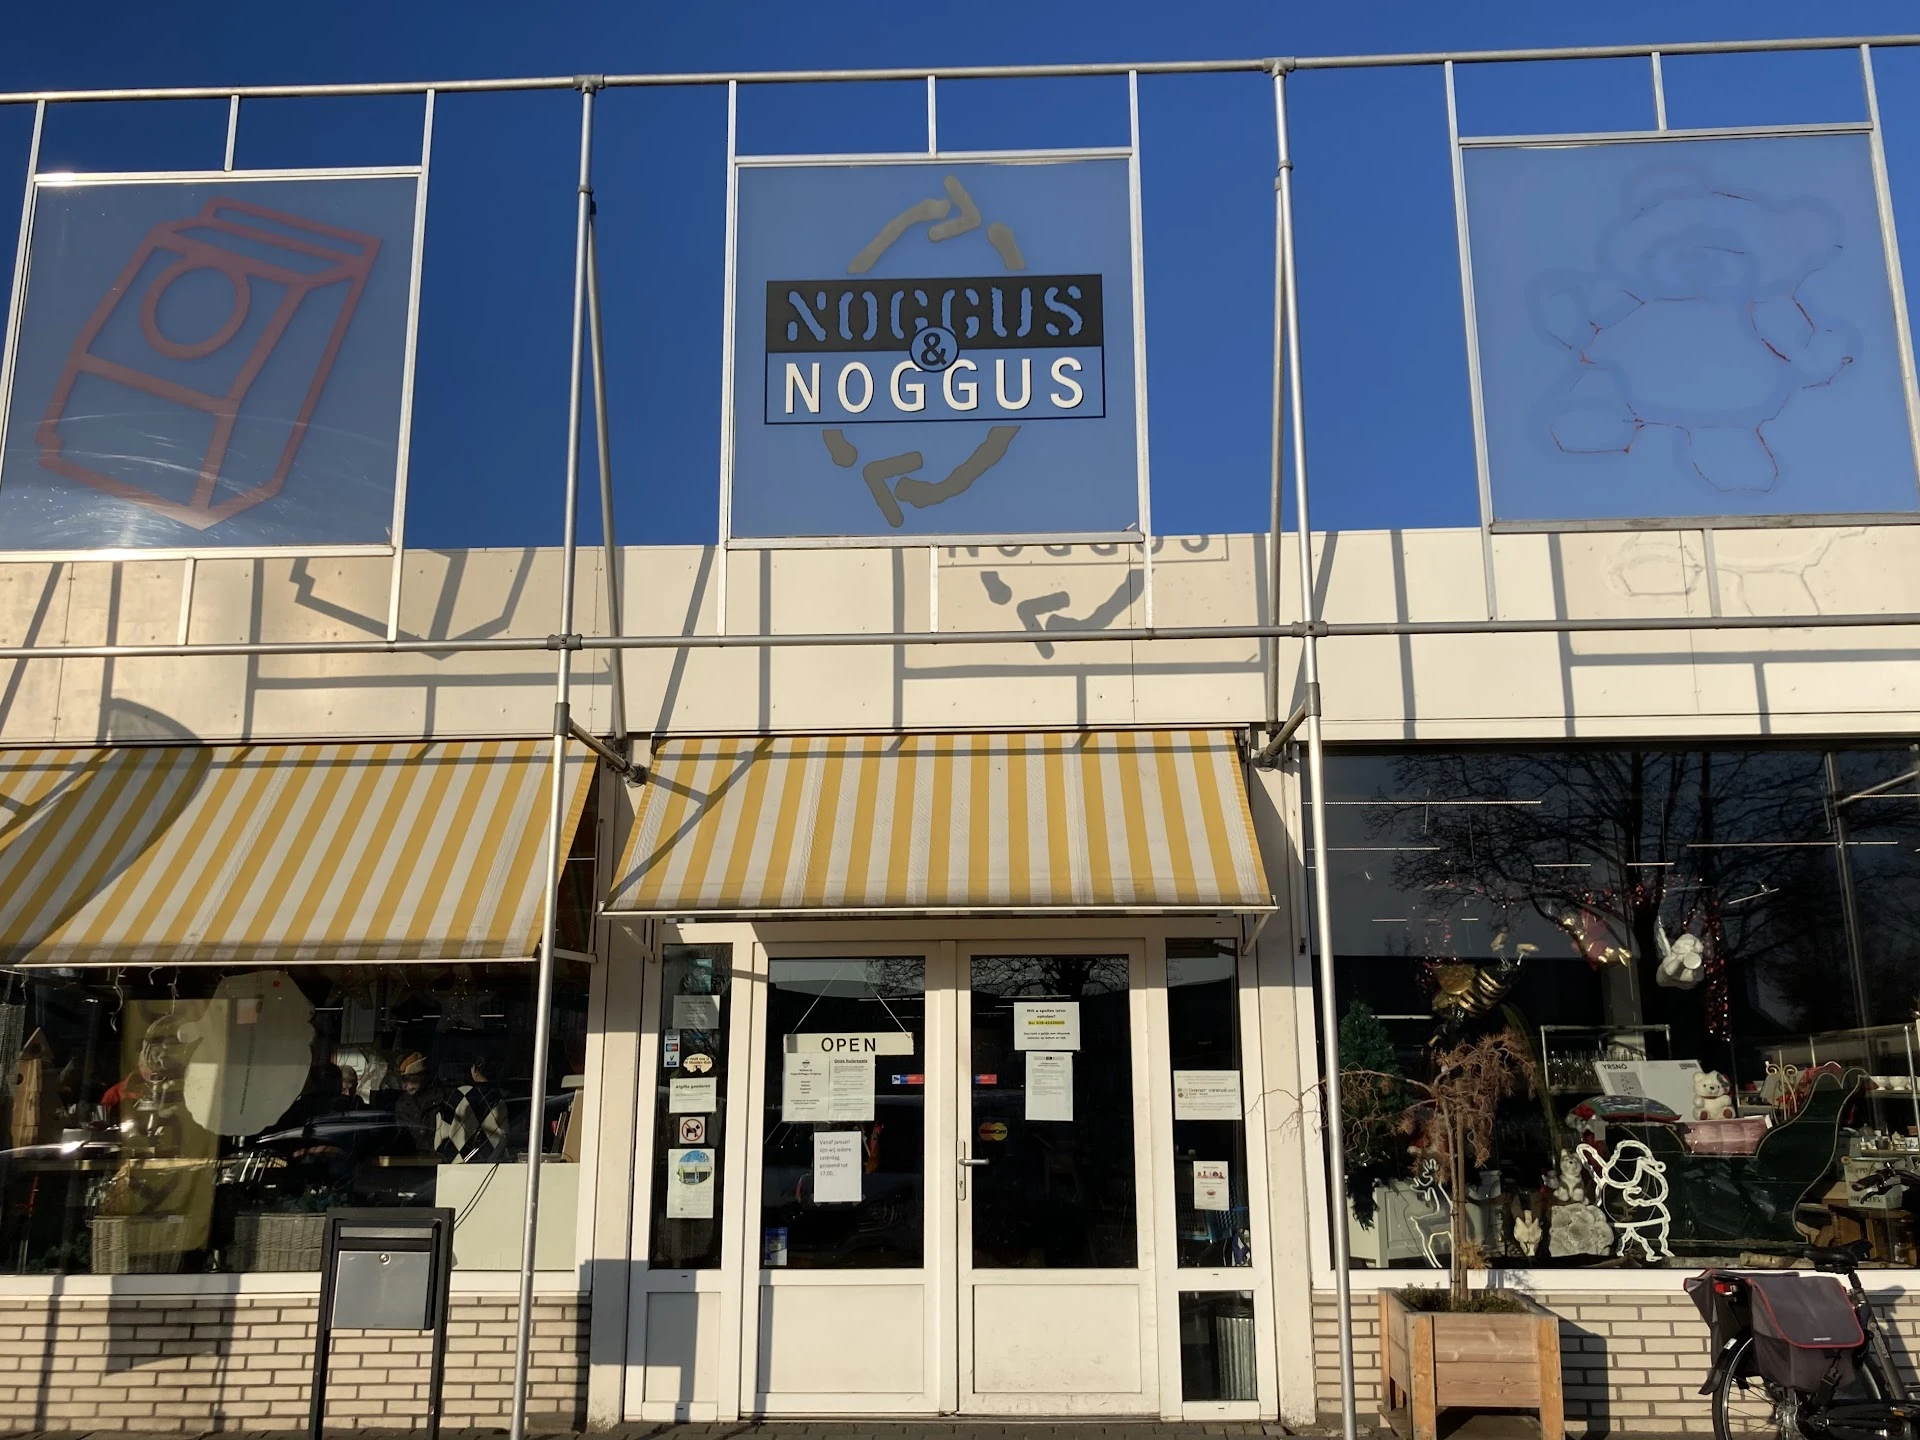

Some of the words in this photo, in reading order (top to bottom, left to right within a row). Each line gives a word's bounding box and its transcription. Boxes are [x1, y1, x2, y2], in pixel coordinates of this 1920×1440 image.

[786, 285, 1085, 343] NOGGUS
[920, 332, 947, 367] &
[784, 356, 1086, 415] NOGGUS
[821, 1037, 876, 1052] OPEN
